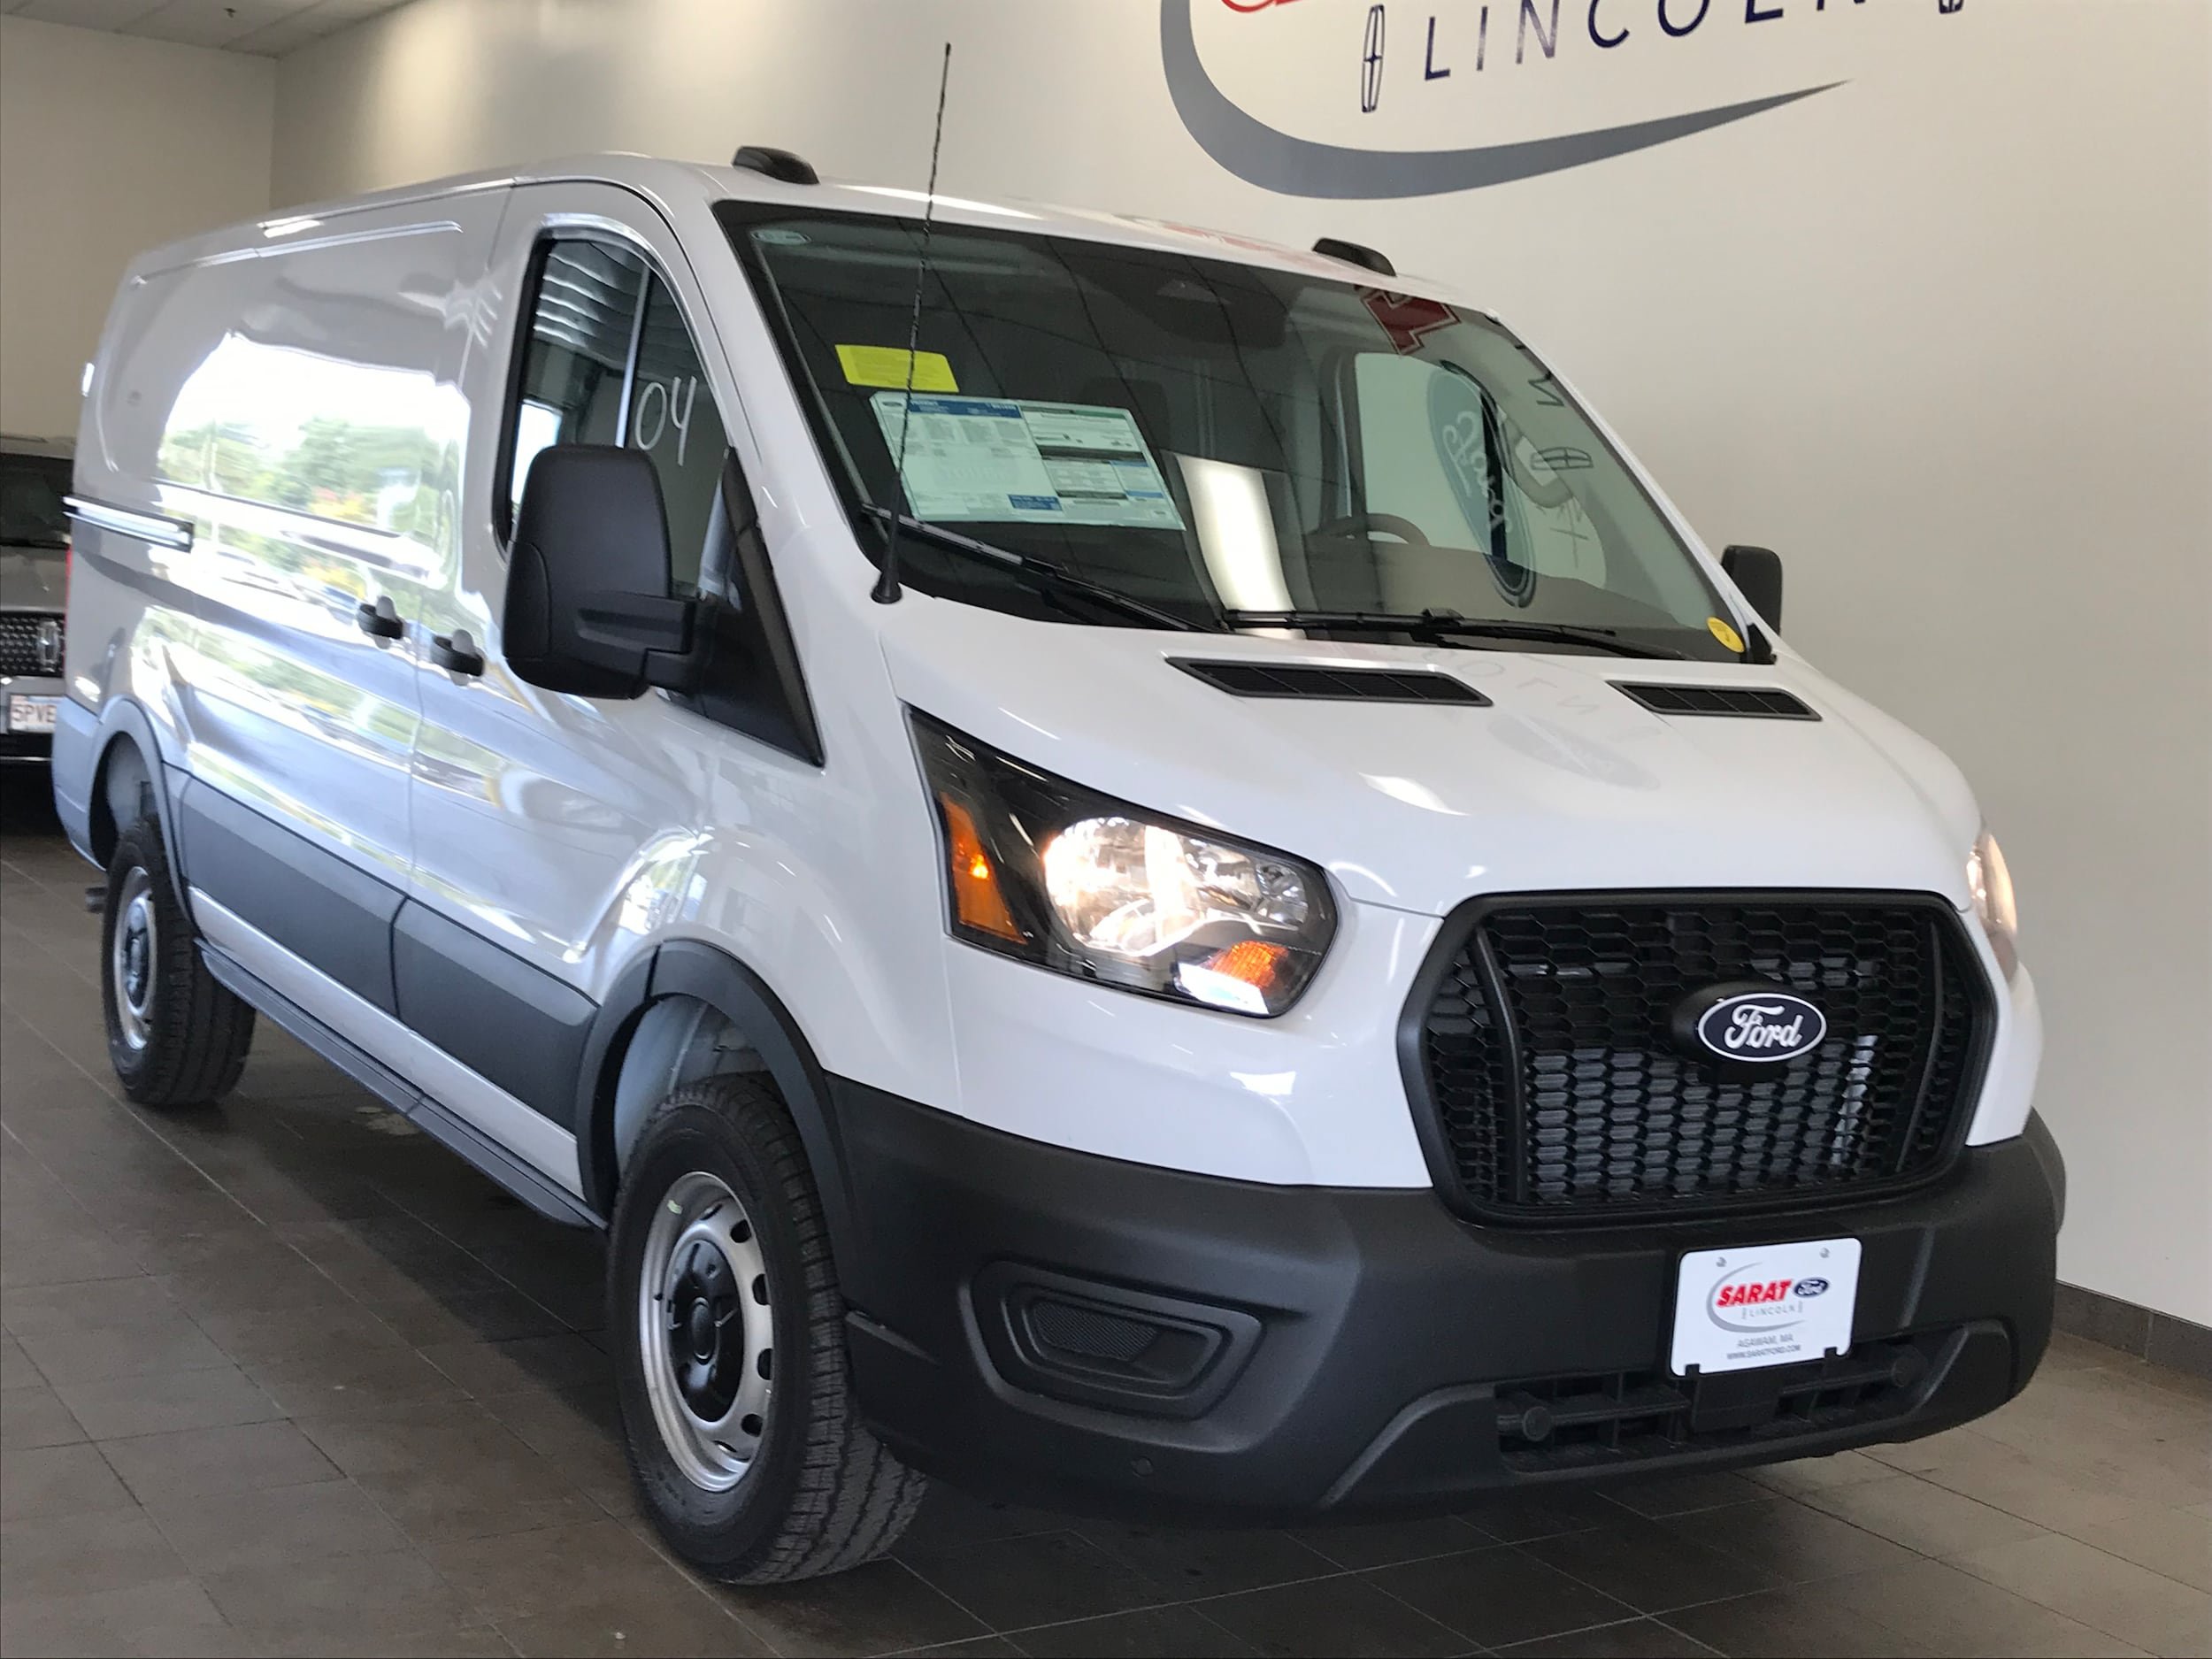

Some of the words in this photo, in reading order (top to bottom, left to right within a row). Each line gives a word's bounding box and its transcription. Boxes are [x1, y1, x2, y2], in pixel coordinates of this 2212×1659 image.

[1425, 0, 1863, 81] LINCO
[635, 376, 697, 466] 04
[1724, 1004, 1804, 1048] Ford
[1717, 1279, 1793, 1307] SARAT
